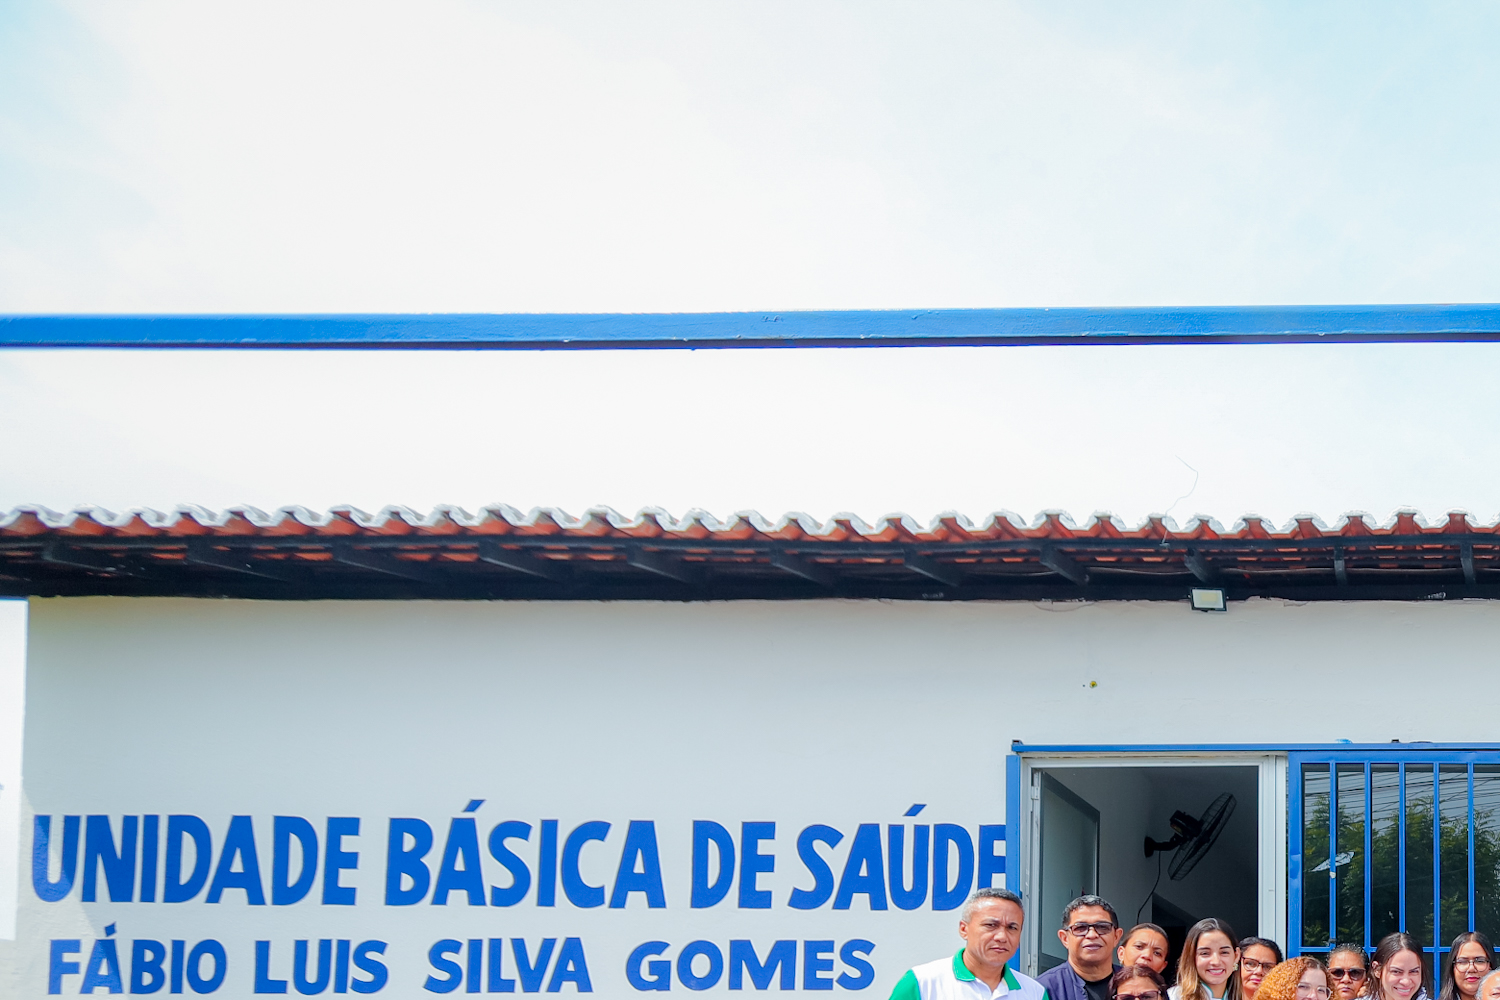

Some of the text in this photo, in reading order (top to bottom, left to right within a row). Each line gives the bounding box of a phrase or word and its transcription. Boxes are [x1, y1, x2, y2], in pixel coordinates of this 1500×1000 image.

[32, 813, 361, 906] UNIDADE
[384, 799, 667, 907] BÁSICA
[690, 819, 776, 909] DE
[47, 921, 877, 996] FÁBIO LUIS SILVA GOMES
